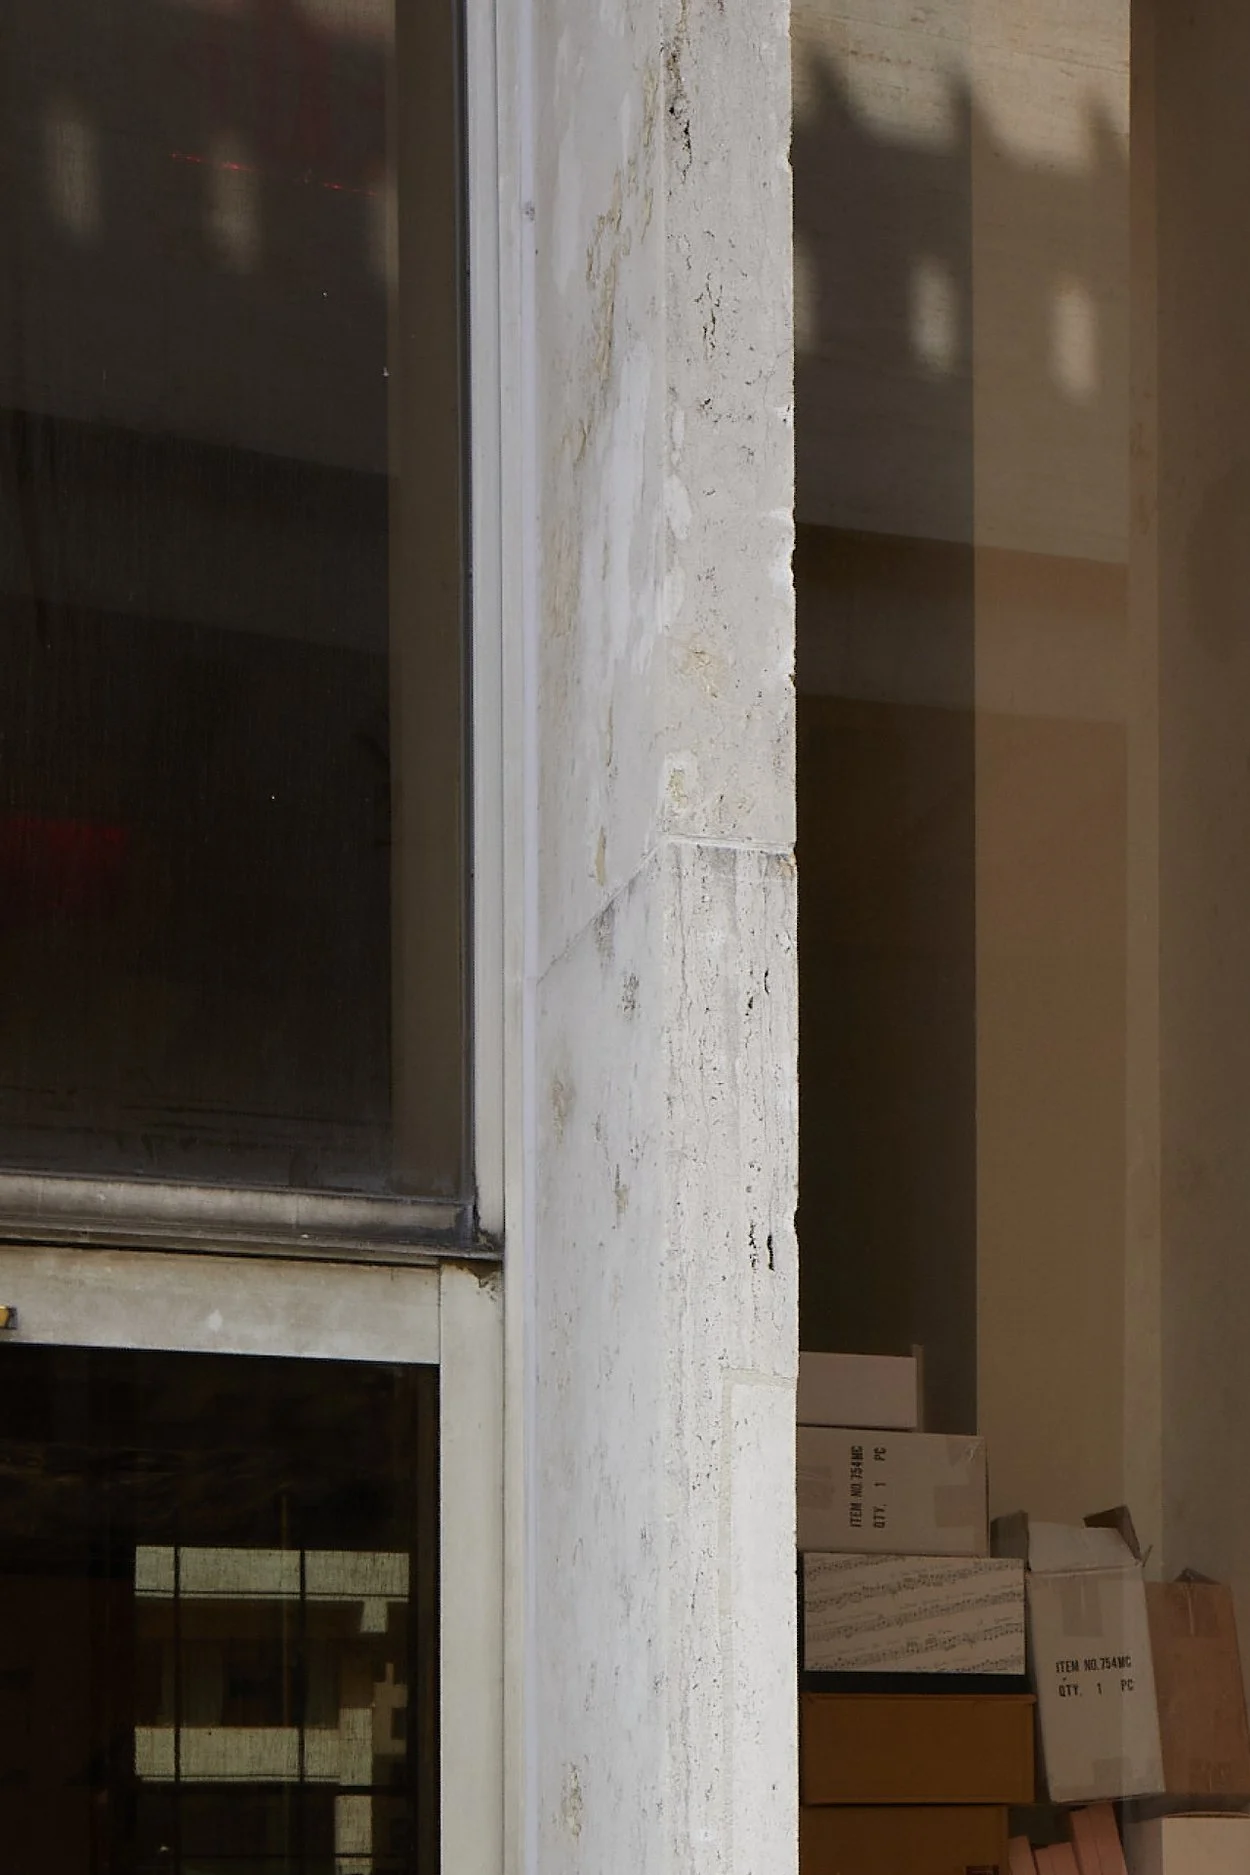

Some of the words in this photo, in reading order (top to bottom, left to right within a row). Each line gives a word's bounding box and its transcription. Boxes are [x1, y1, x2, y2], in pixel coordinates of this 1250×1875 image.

[873, 1447, 887, 1462] PC
[849, 1502, 863, 1528] ITEM
[1056, 1660, 1079, 1672] ITEM
[1097, 1682, 1102, 1695] 1
[1121, 1679, 1134, 1692] PC
